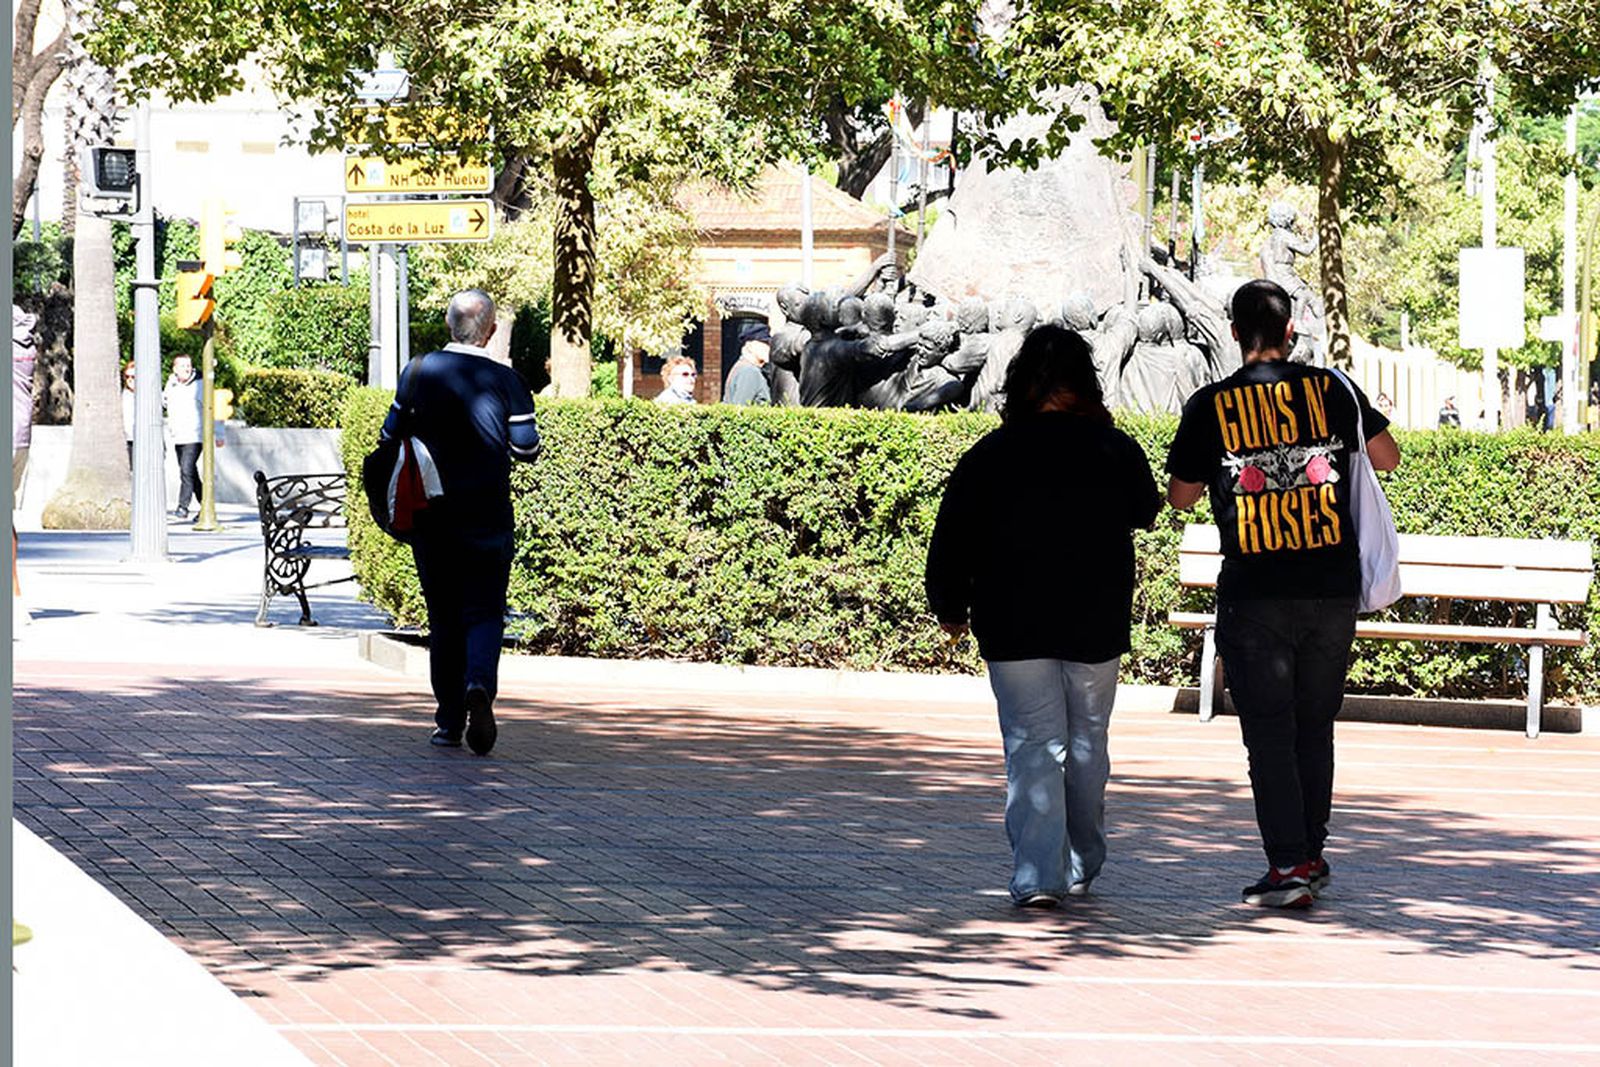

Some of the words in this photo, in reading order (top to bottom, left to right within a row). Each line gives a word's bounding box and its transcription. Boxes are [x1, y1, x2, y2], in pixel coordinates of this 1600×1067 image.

[390, 174, 409, 186] NH
[416, 174, 437, 186] Luz
[444, 173, 487, 186] Huelva
[348, 210, 369, 218] hotel
[348, 223, 383, 235] Costa
[388, 222, 403, 235] de
[408, 222, 418, 235] la
[424, 223, 445, 234] Luz
[1214, 381, 1299, 453] GUNS
[1236, 483, 1341, 554] ROSES
